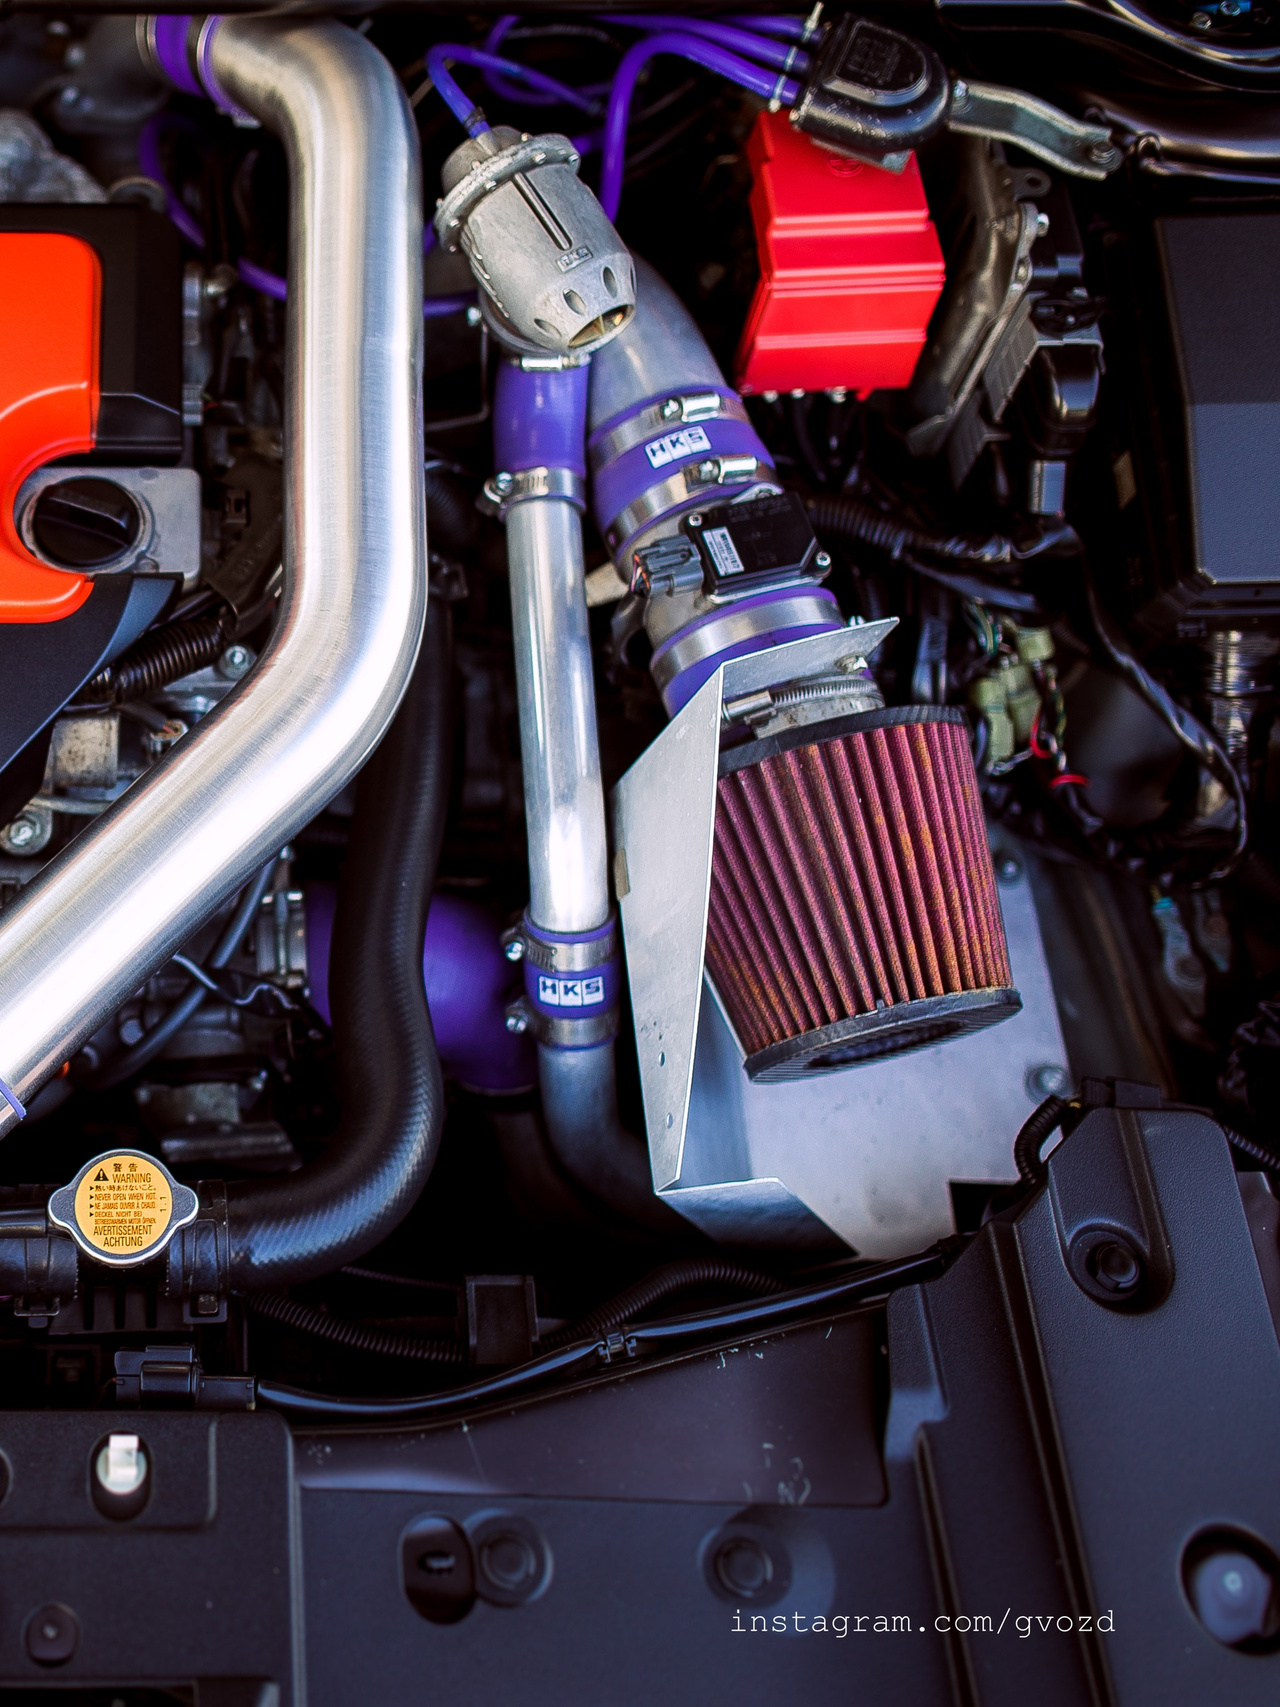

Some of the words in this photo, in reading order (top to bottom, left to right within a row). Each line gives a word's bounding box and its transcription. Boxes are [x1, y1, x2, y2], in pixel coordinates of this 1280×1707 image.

[648, 430, 705, 458] HKS
[541, 979, 601, 997] HKS
[112, 1173, 151, 1183] WARNING
[93, 1225, 152, 1236] AVERTISSEMENT
[103, 1236, 143, 1247] ACHTUNG
